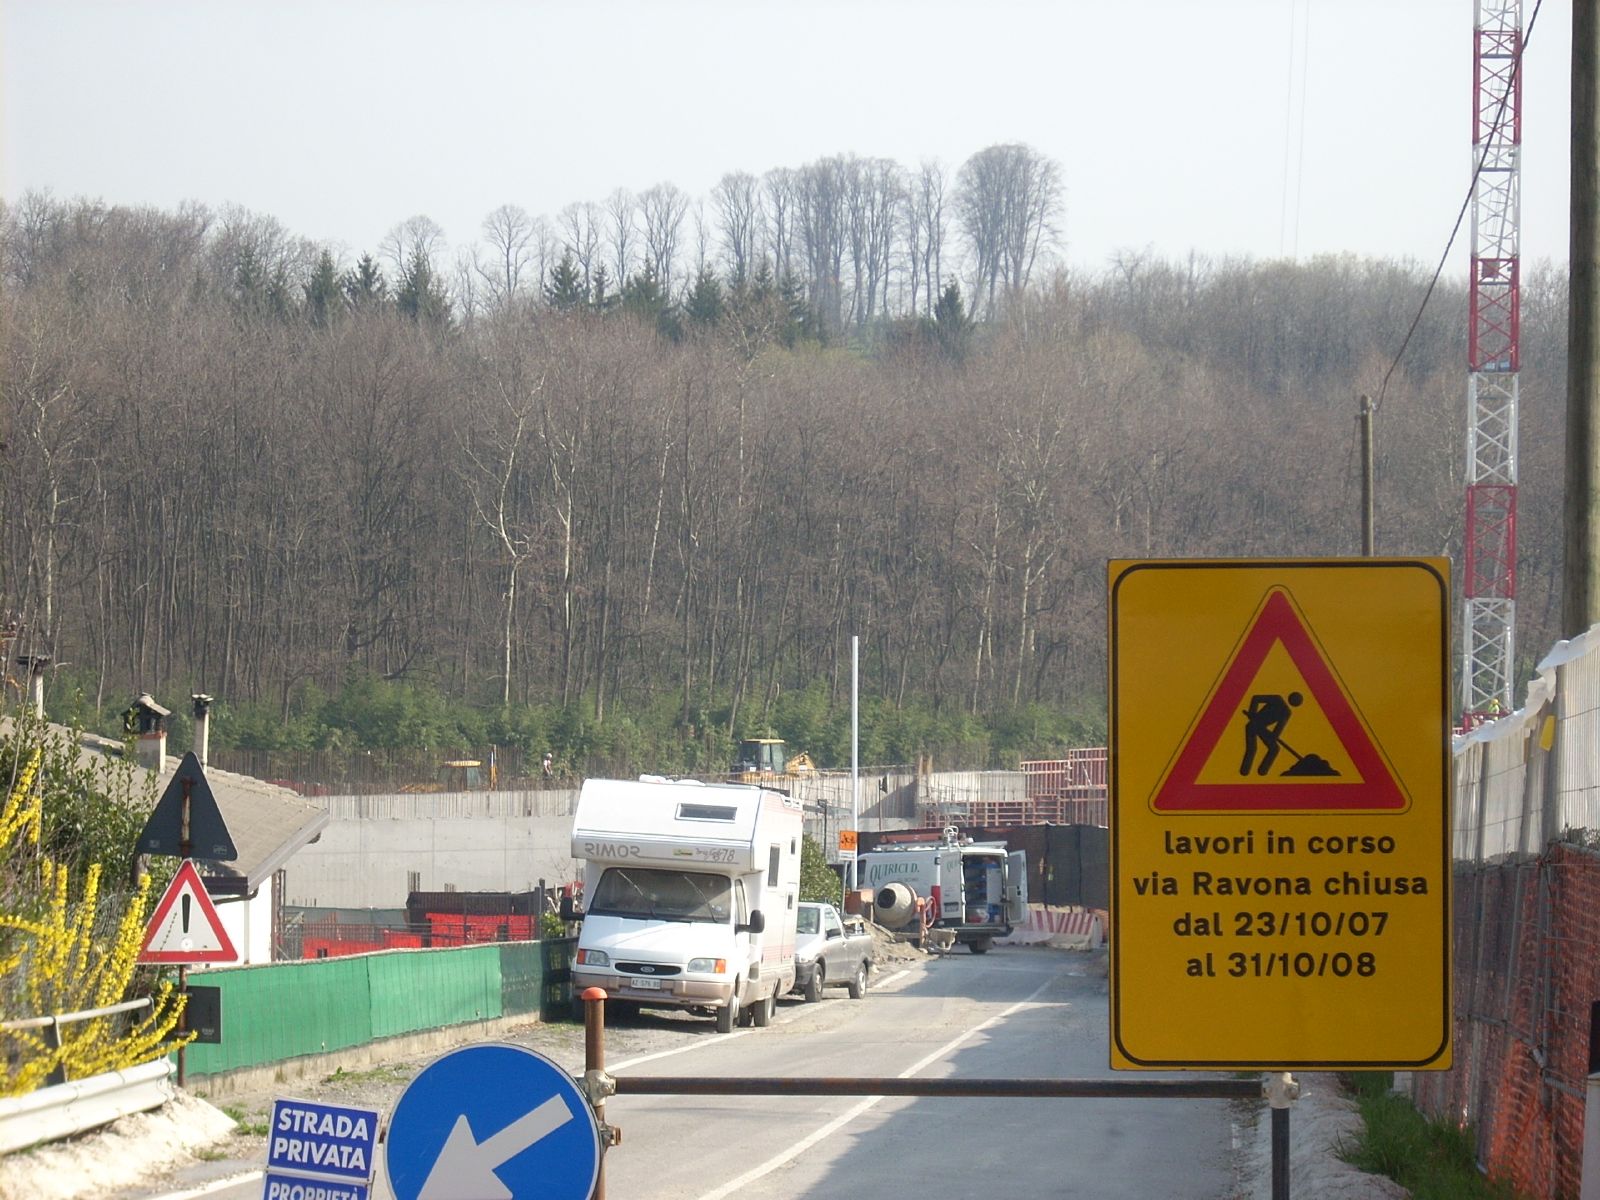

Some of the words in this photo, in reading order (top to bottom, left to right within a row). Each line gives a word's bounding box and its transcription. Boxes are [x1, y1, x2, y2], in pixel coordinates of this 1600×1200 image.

[584, 842, 640, 858] RIMOR
[1164, 830, 1254, 854] lavori
[1267, 830, 1295, 854] in
[1307, 835, 1396, 854] corso
[870, 863, 908, 886] QUIRICI
[1133, 871, 1179, 896] via
[1193, 872, 1312, 896] Ravona
[1324, 871, 1428, 896] chiusa
[1173, 912, 1223, 937] dal
[1234, 912, 1389, 937] 23/10/07
[1186, 953, 1216, 977] al
[1228, 952, 1377, 977] 31/10/08
[278, 1108, 369, 1141] STRADA
[273, 1137, 366, 1170] PRIVATA
